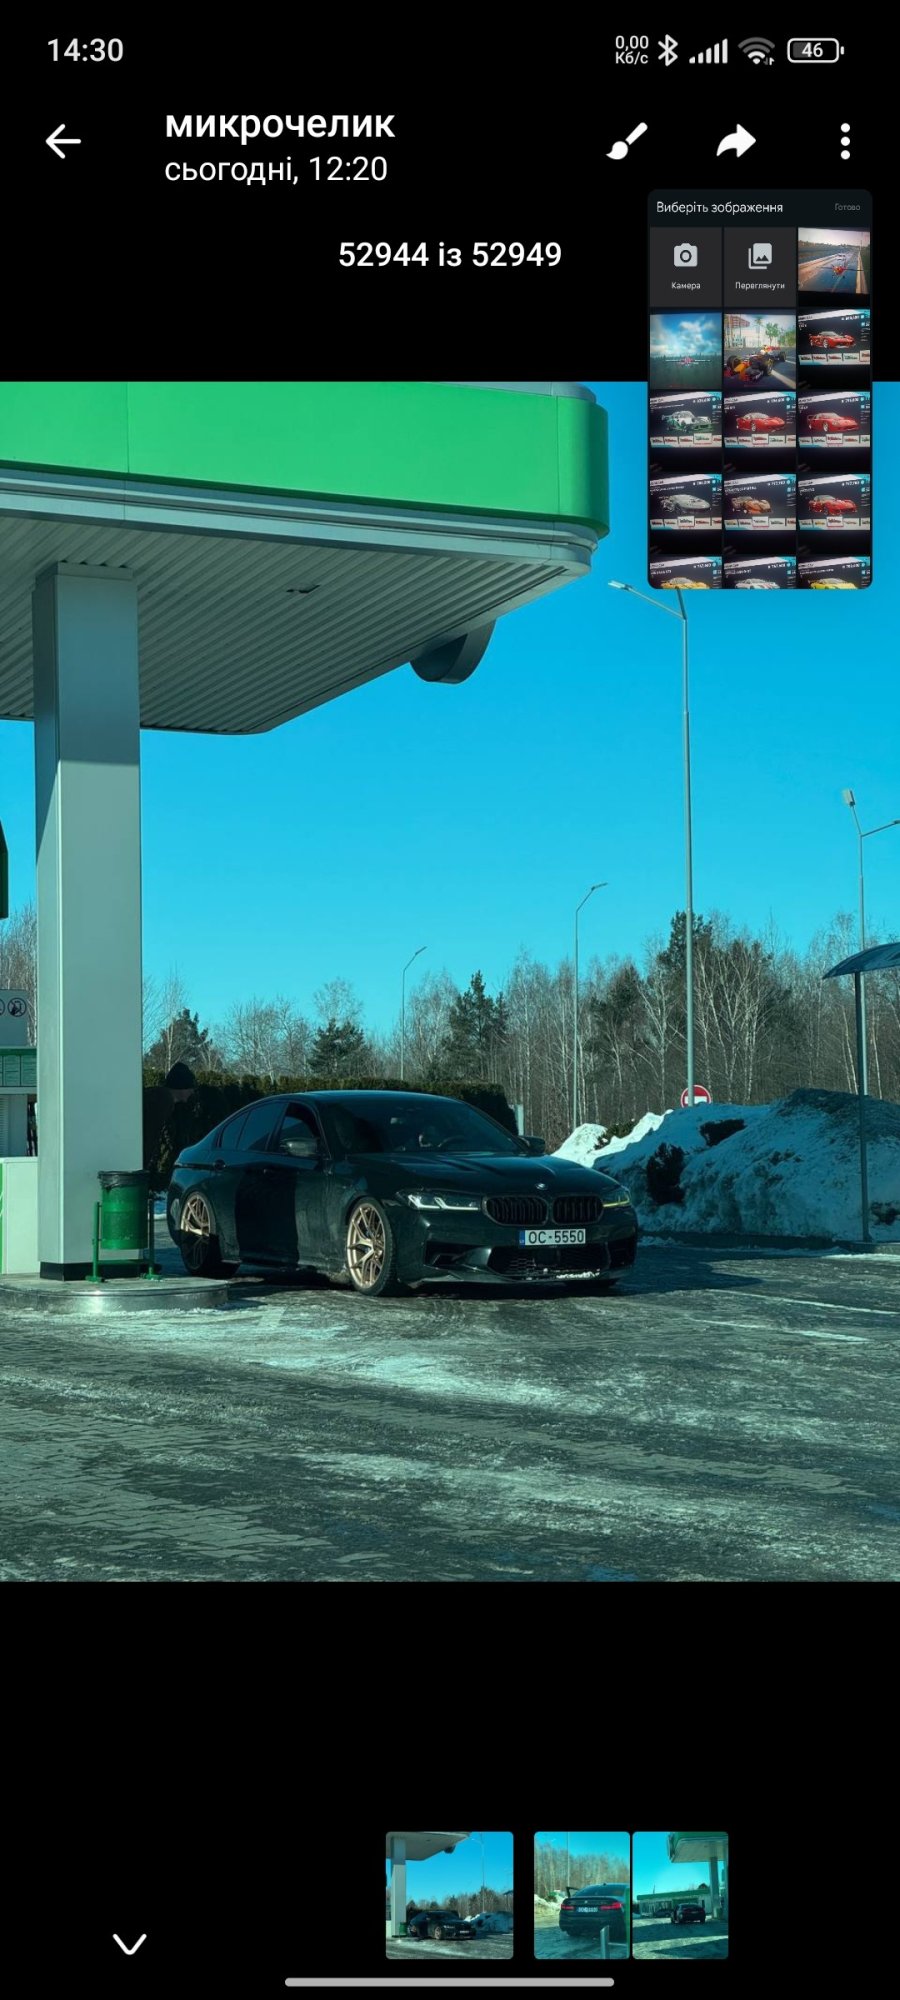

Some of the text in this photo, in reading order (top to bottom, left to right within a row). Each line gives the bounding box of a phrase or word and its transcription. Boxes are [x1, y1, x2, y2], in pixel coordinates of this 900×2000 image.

[47, 38, 124, 62] 14:30
[615, 35, 649, 52] 0,00
[802, 43, 824, 58] 46
[615, 51, 649, 65] Кб/с
[166, 114, 396, 146] микрочелик
[164, 154, 388, 186] сьогодні, 12:20
[656, 201, 784, 215] Виберіть зображення
[834, 202, 861, 211] Готово
[338, 241, 562, 267] 52944 із 52949
[671, 281, 701, 291] Камера
[735, 281, 786, 291] Переглянути
[528, 1230, 584, 1244] OC-5550
